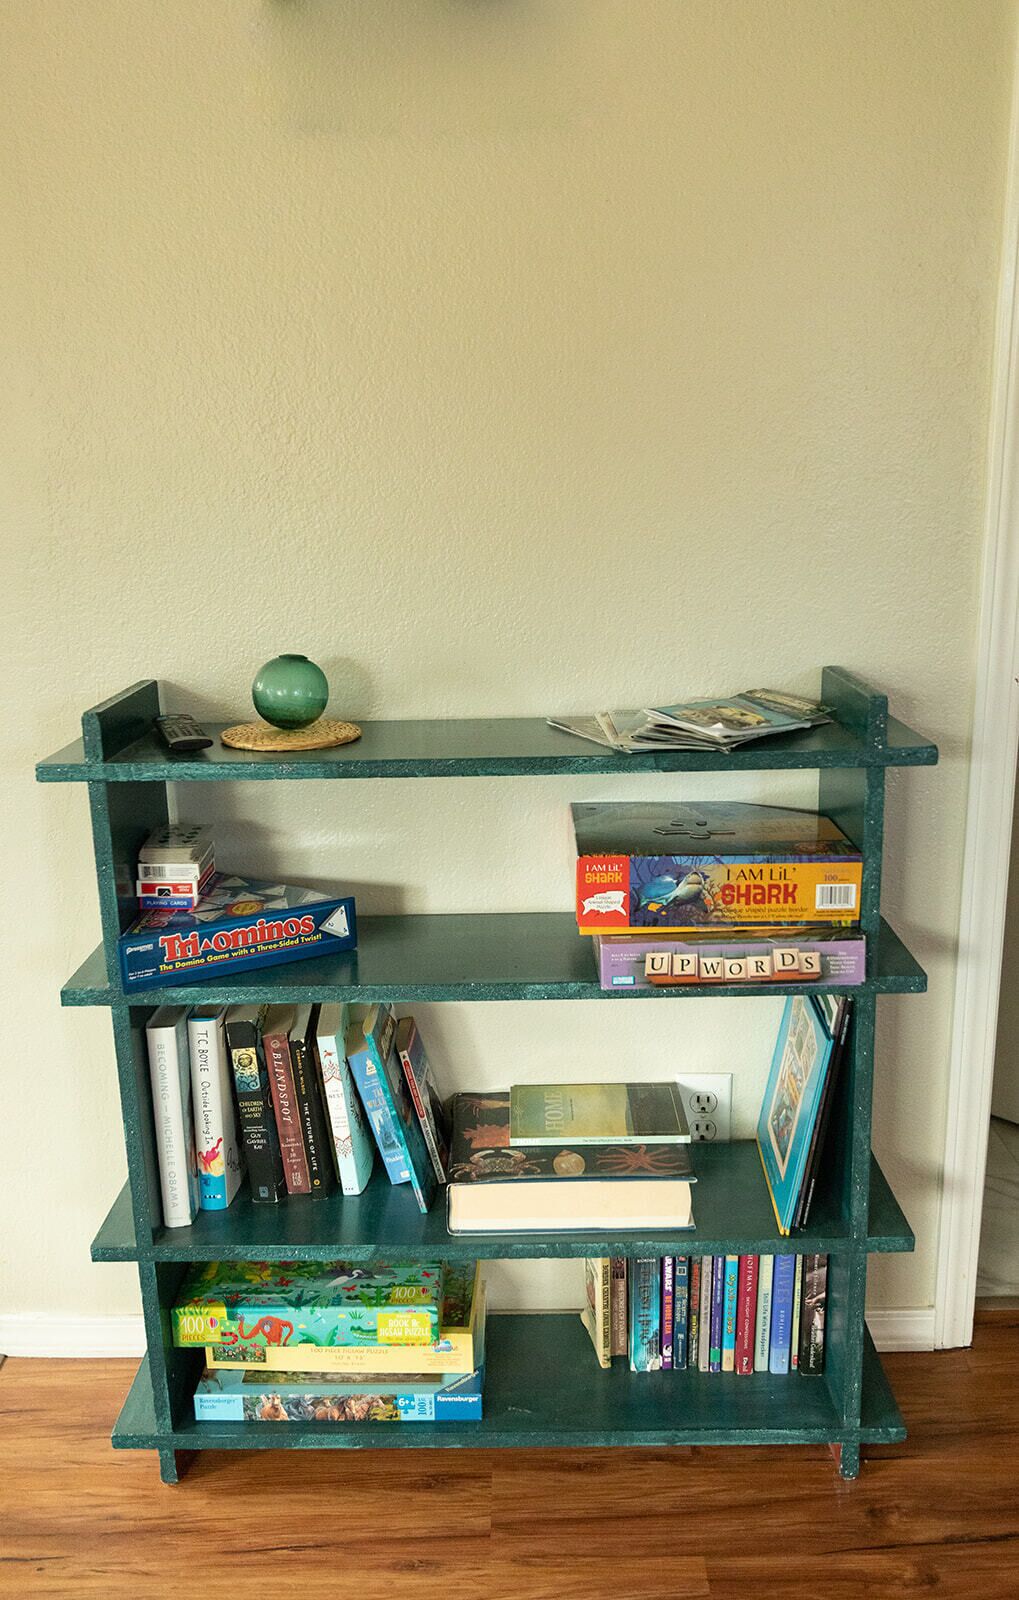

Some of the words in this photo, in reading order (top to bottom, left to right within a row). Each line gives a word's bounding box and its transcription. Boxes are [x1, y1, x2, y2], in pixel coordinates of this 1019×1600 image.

[727, 868, 731, 881] I
[735, 868, 763, 881] AM
[160, 963, 173, 972] The
[175, 958, 205, 969] Domino
[206, 953, 230, 962] Game
[231, 948, 249, 957] with
[257, 939, 300, 952] Three-Sided
[301, 933, 322, 944] Twist!
[197, 1049, 209, 1072] BOYLE
[156, 1043, 170, 1101] BECOMING
[200, 1080, 212, 1108] Outside
[272, 1051, 292, 1124] BLINDSPOT
[544, 1091, 565, 1132] HOME
[200, 1109, 213, 1134] Looking
[304, 1117, 313, 1143] FUTURE
[161, 1115, 175, 1166] MICHELLE
[204, 1135, 213, 1144] In
[308, 1145, 315, 1154] OF
[310, 1156, 318, 1171] LIFE
[167, 1170, 179, 1208] OBAMA
[728, 1273, 736, 1286] My
[394, 1286, 416, 1299] 100
[180, 1316, 205, 1334] 100
[380, 1327, 403, 1337] JIGSAW
[404, 1327, 430, 1337] PUZZLE
[388, 1319, 409, 1328] BOOK
[398, 1398, 409, 1407] 6+
[436, 1395, 479, 1403] Ravensburger
